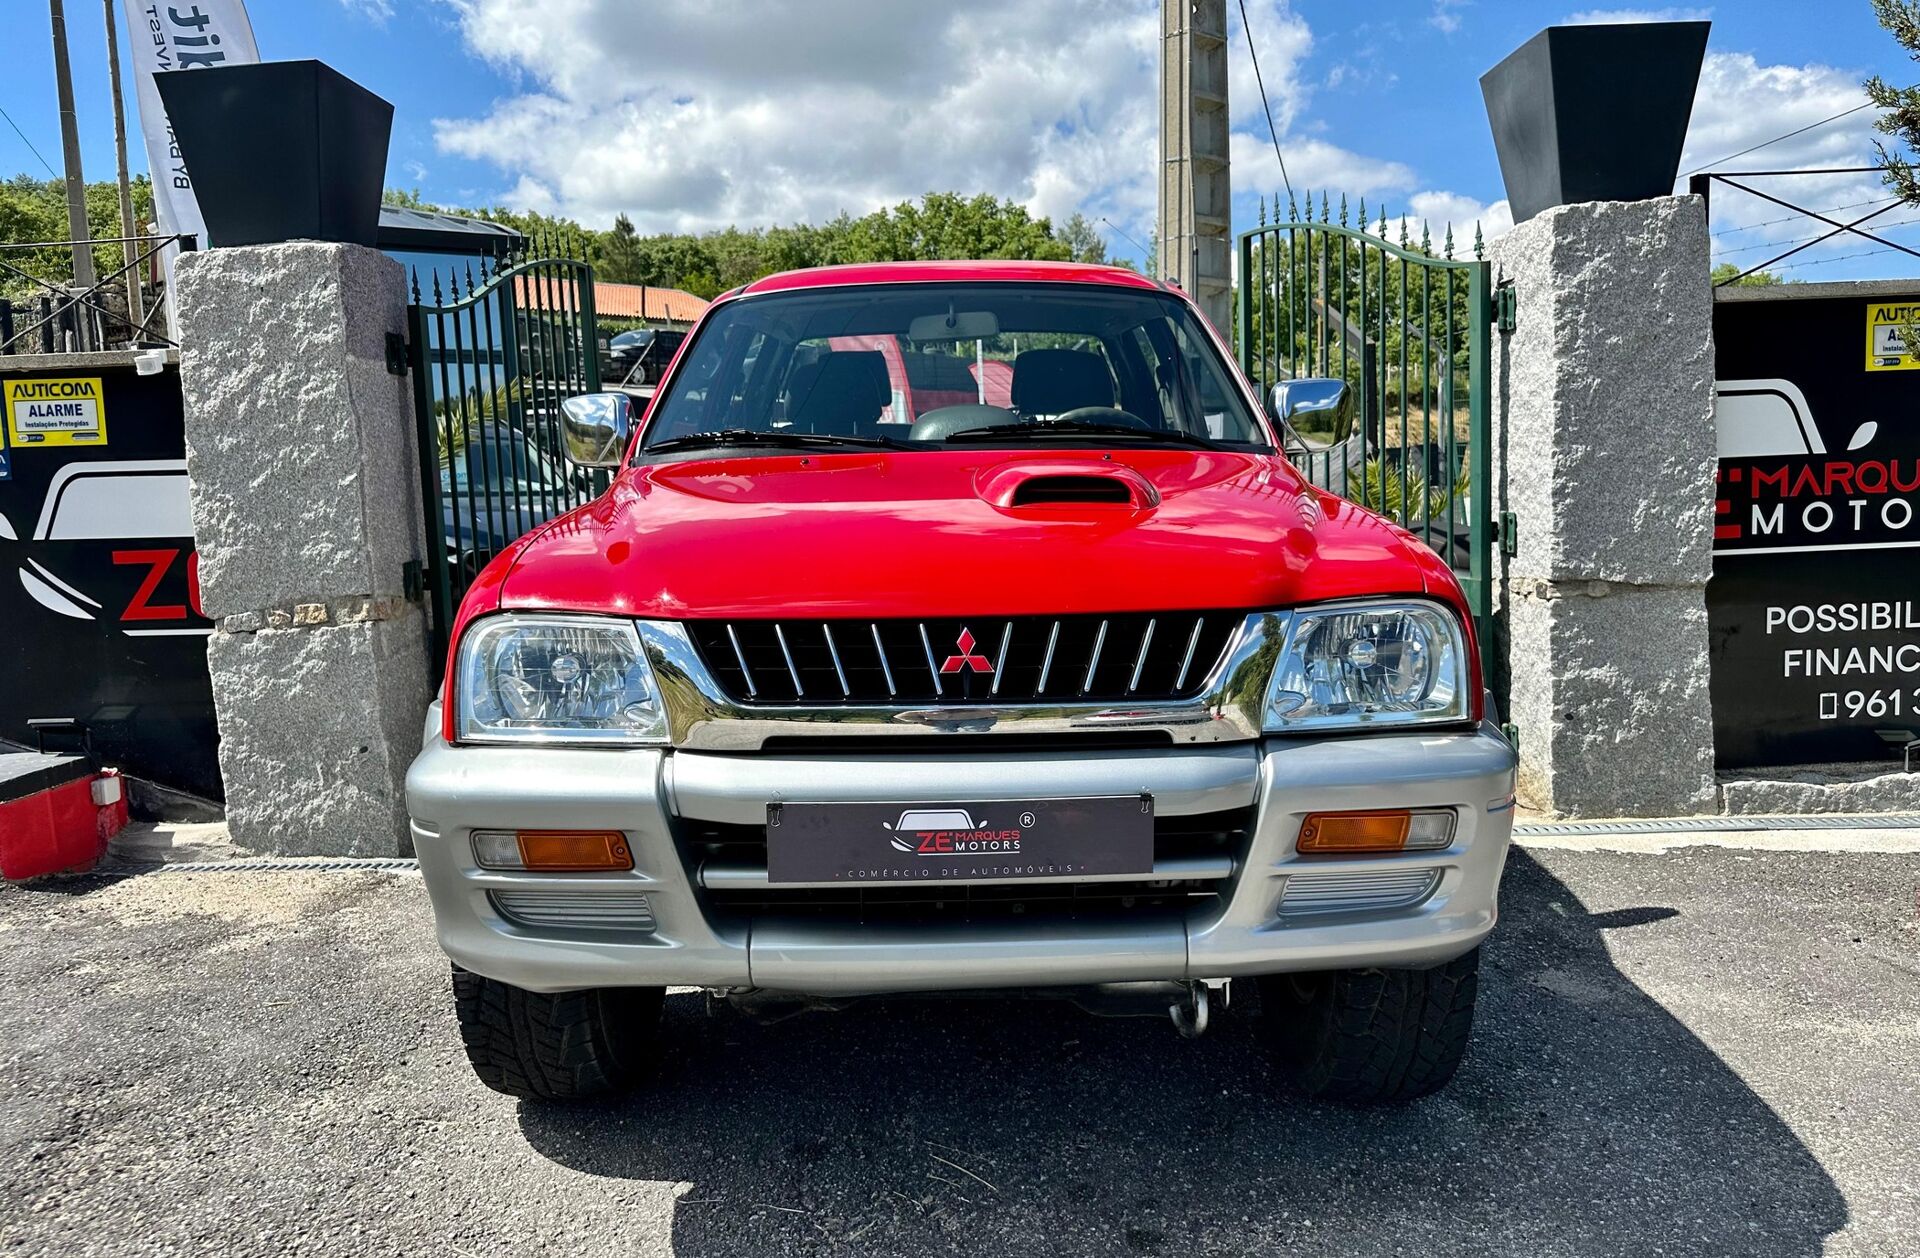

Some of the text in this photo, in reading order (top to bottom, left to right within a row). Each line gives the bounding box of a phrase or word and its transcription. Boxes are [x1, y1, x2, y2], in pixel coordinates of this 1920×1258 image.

[12, 382, 96, 398] AUTICOM
[28, 403, 84, 417] ALARME
[59, 420, 89, 428] Protegidas
[1751, 458, 1920, 498] MARQU
[1751, 498, 1912, 535] MOTO
[1766, 601, 1920, 634] POSSIBIL
[1784, 644, 1920, 677] FINANC
[1844, 689, 1901, 719] 961
[955, 830, 1021, 841] MARQUES
[955, 840, 1021, 851] MOTORS
[847, 863, 1073, 878] COMÉRCIO DE AUTOMÓVEIS
